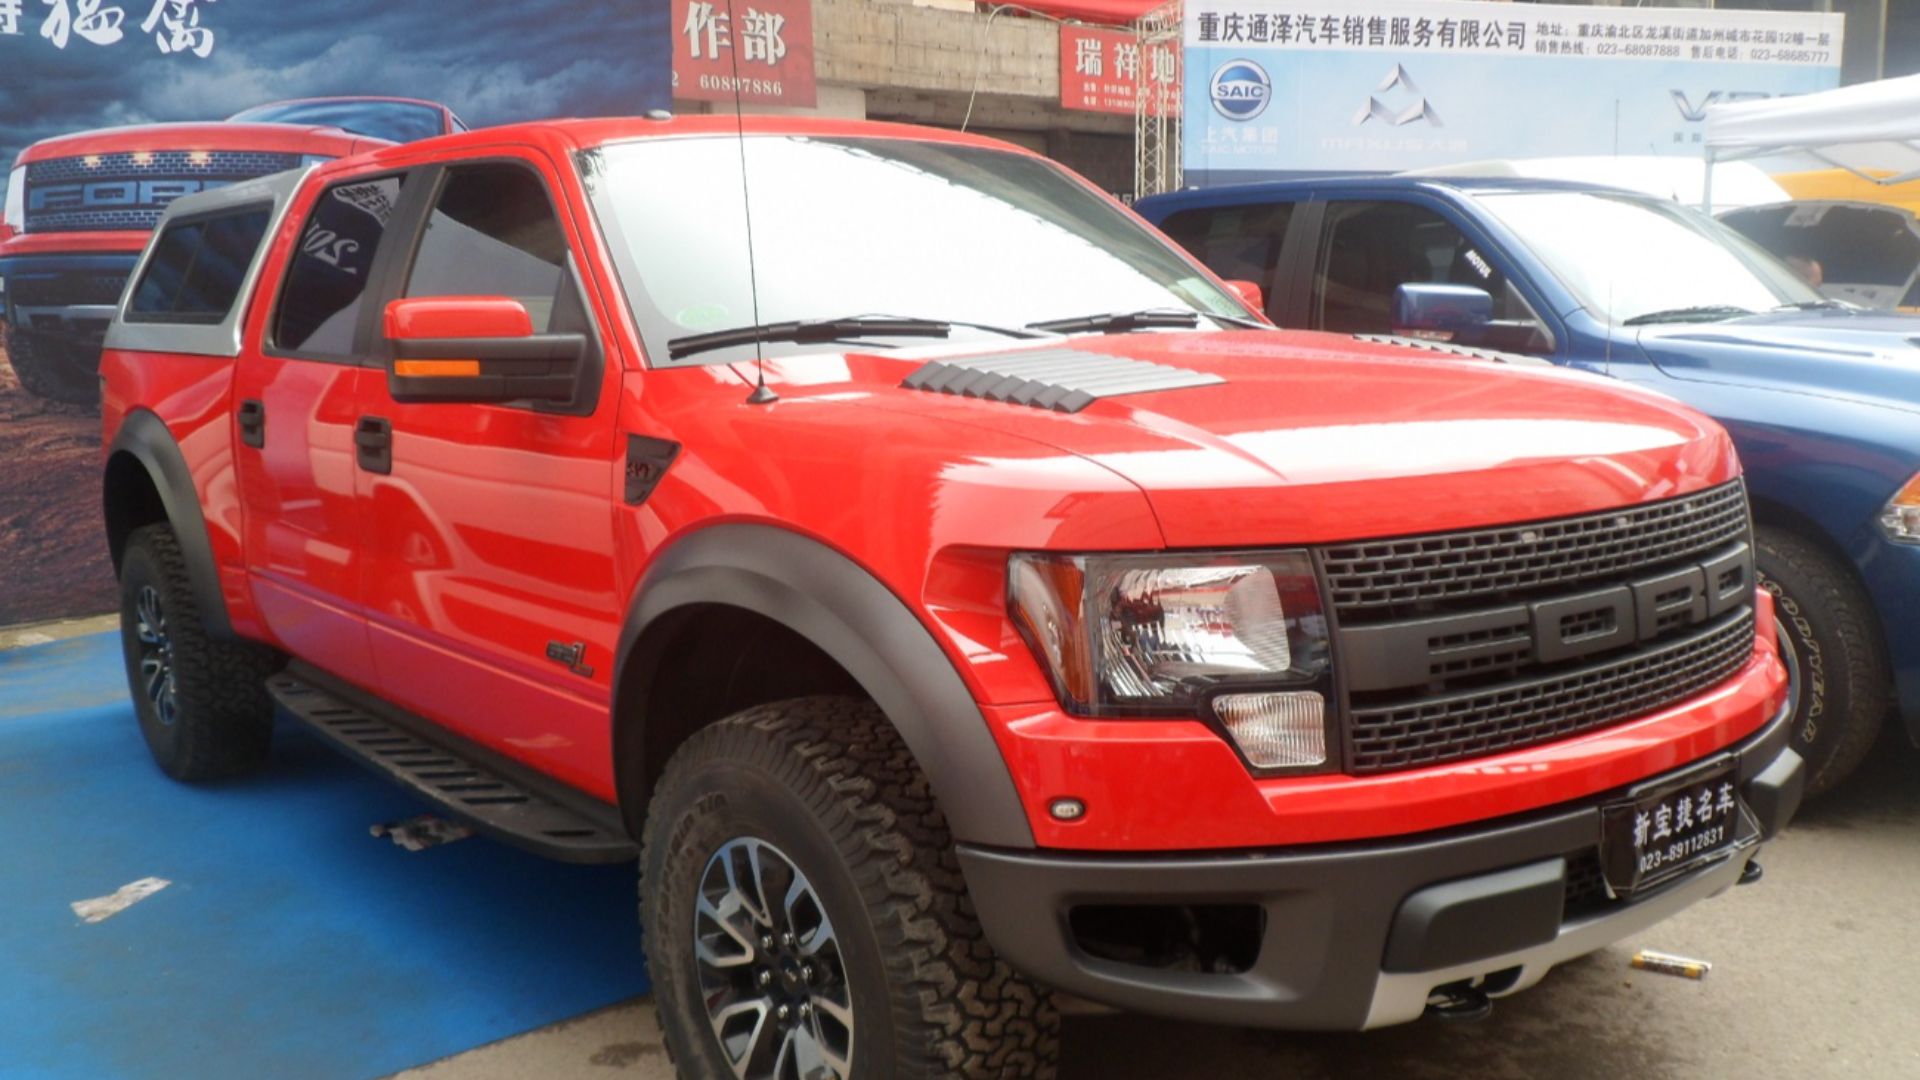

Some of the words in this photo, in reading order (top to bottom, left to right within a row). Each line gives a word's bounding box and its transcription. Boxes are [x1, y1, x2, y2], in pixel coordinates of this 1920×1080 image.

[1198, 11, 1527, 50] 重庆通泽汽车销售服务有限公司
[700, 73, 783, 96] 60897886
[1217, 84, 1264, 98] SAIC
[1201, 126, 1278, 144] 上汽集团
[1340, 542, 1750, 692] FORD
[1640, 826, 1725, 873] 023-89112831
